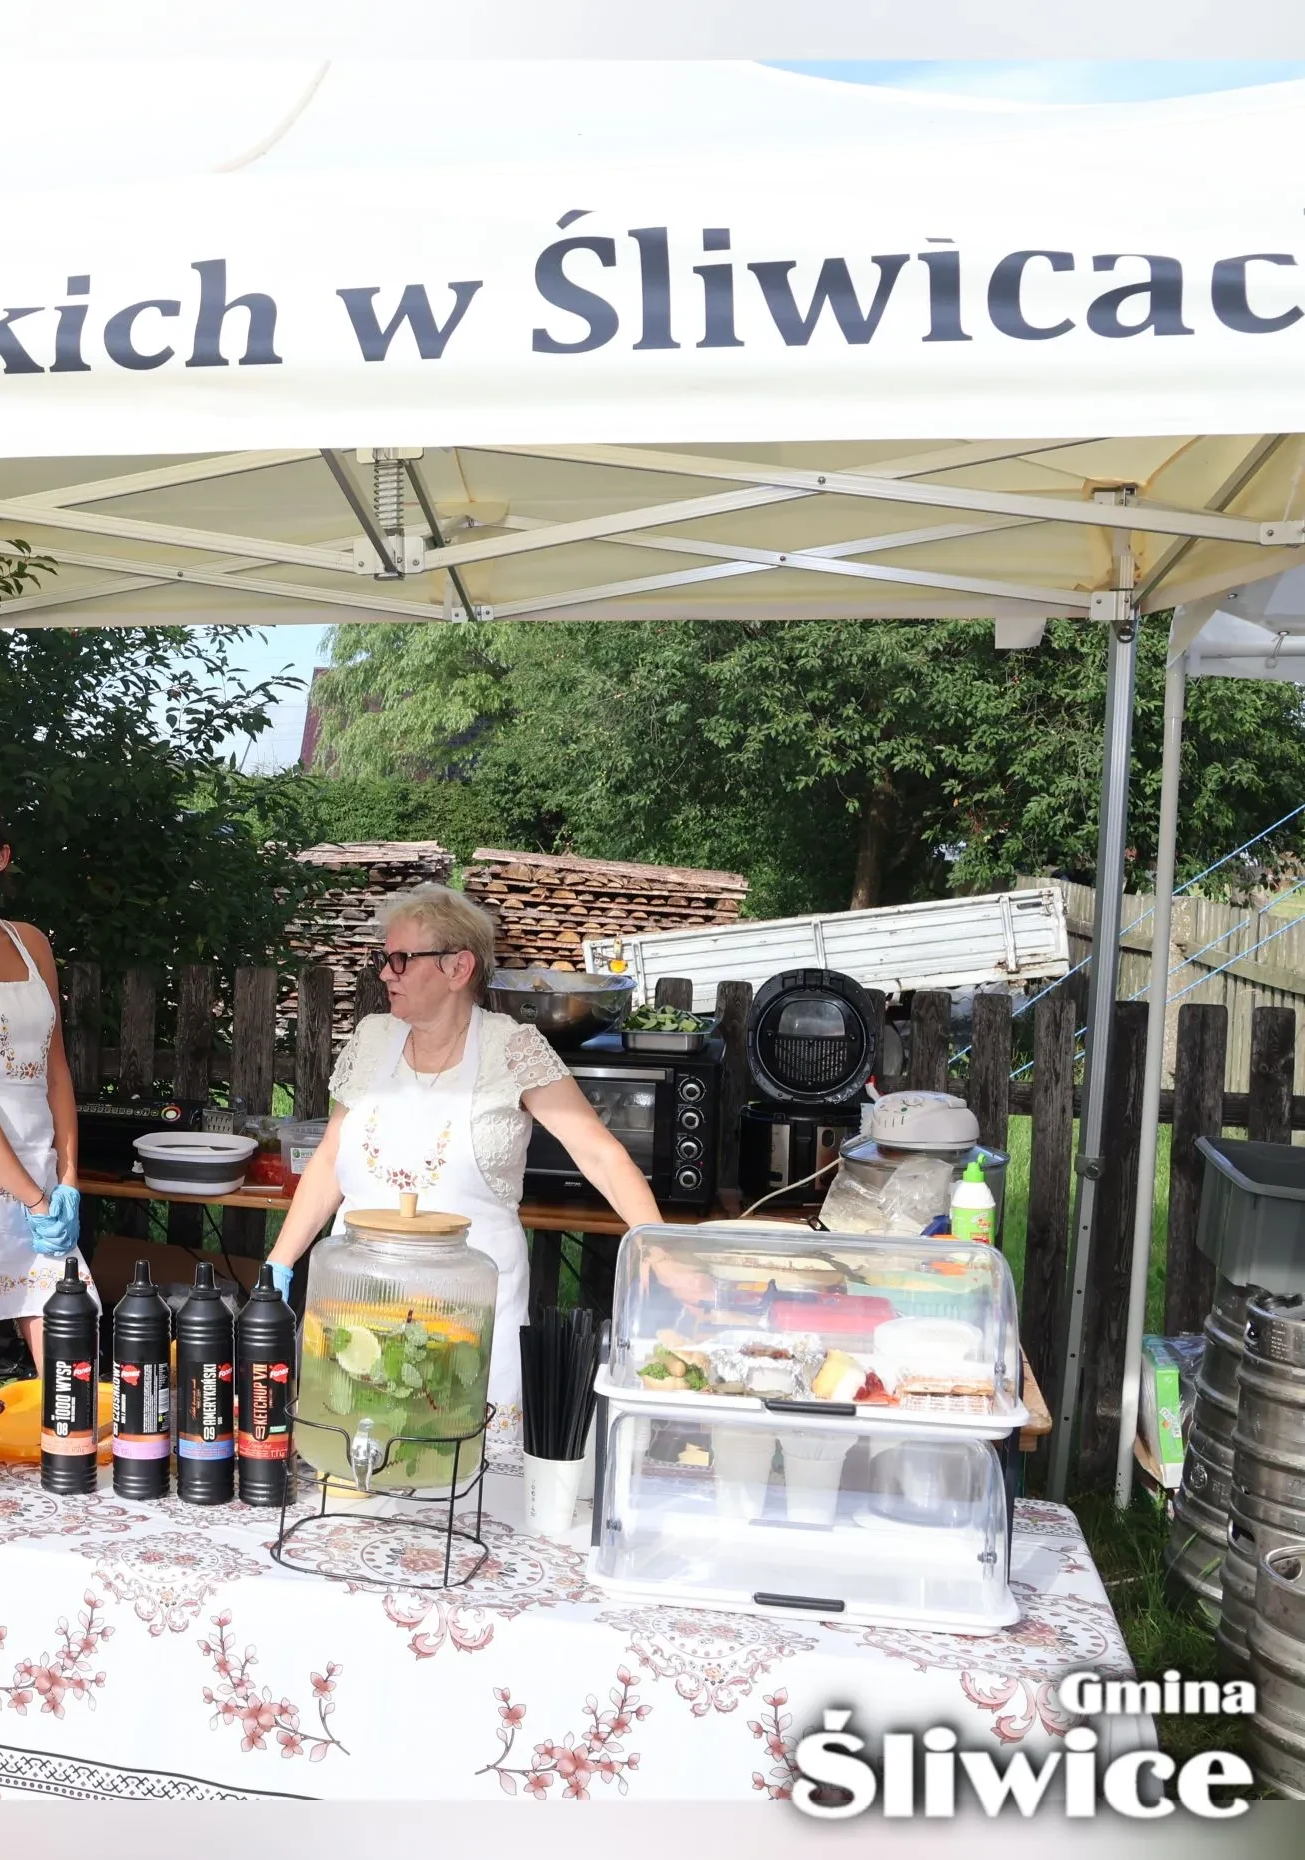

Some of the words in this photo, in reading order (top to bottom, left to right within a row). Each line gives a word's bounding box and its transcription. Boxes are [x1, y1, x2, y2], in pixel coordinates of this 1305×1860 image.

[336, 280, 483, 362] w
[532, 208, 1305, 355] Śliwicac
[55, 1361, 72, 1392] WYSP
[252, 1362, 268, 1381] VII
[55, 1394, 71, 1421] 1000
[201, 1363, 216, 1426] AMERYKAŃSKI
[252, 1382, 267, 1425] KETCHUP
[56, 1422, 68, 1436] 08
[203, 1426, 216, 1441] 09
[255, 1425, 266, 1440] 07
